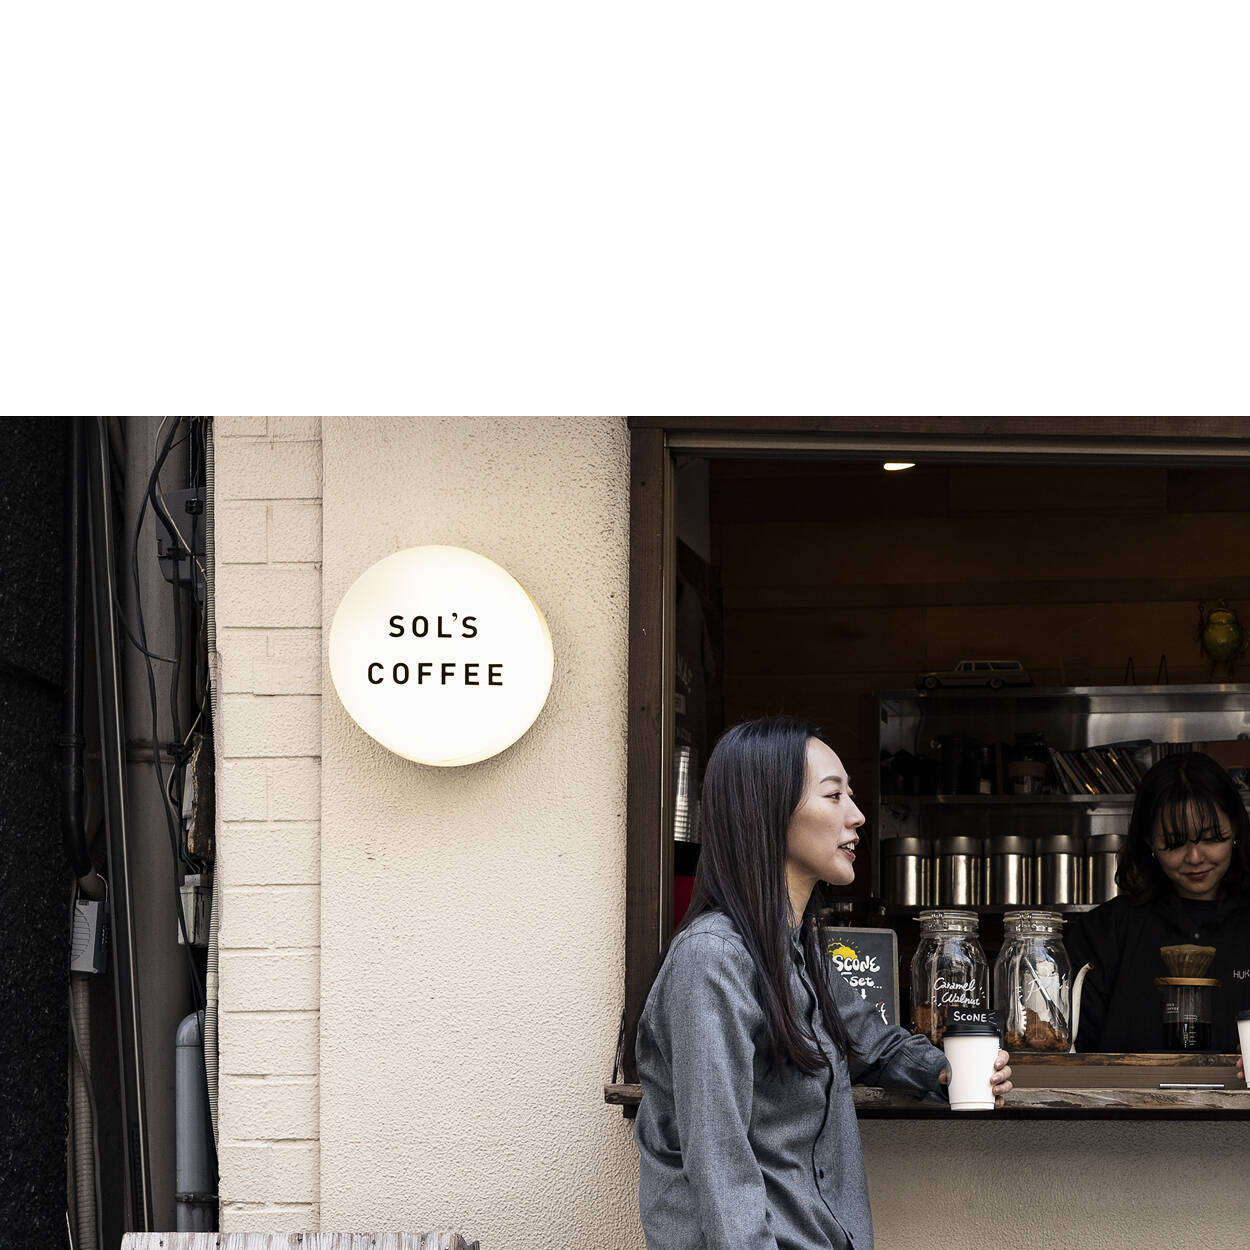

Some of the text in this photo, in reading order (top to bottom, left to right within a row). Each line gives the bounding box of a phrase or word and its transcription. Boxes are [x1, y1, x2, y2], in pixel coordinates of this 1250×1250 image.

[388, 612, 479, 639] SOL'S
[367, 662, 504, 686] COFFEE
[832, 954, 881, 973] SCONE
[933, 977, 976, 992] Caramel
[941, 991, 981, 1006] Walnut
[953, 1010, 988, 1023] SCONE
